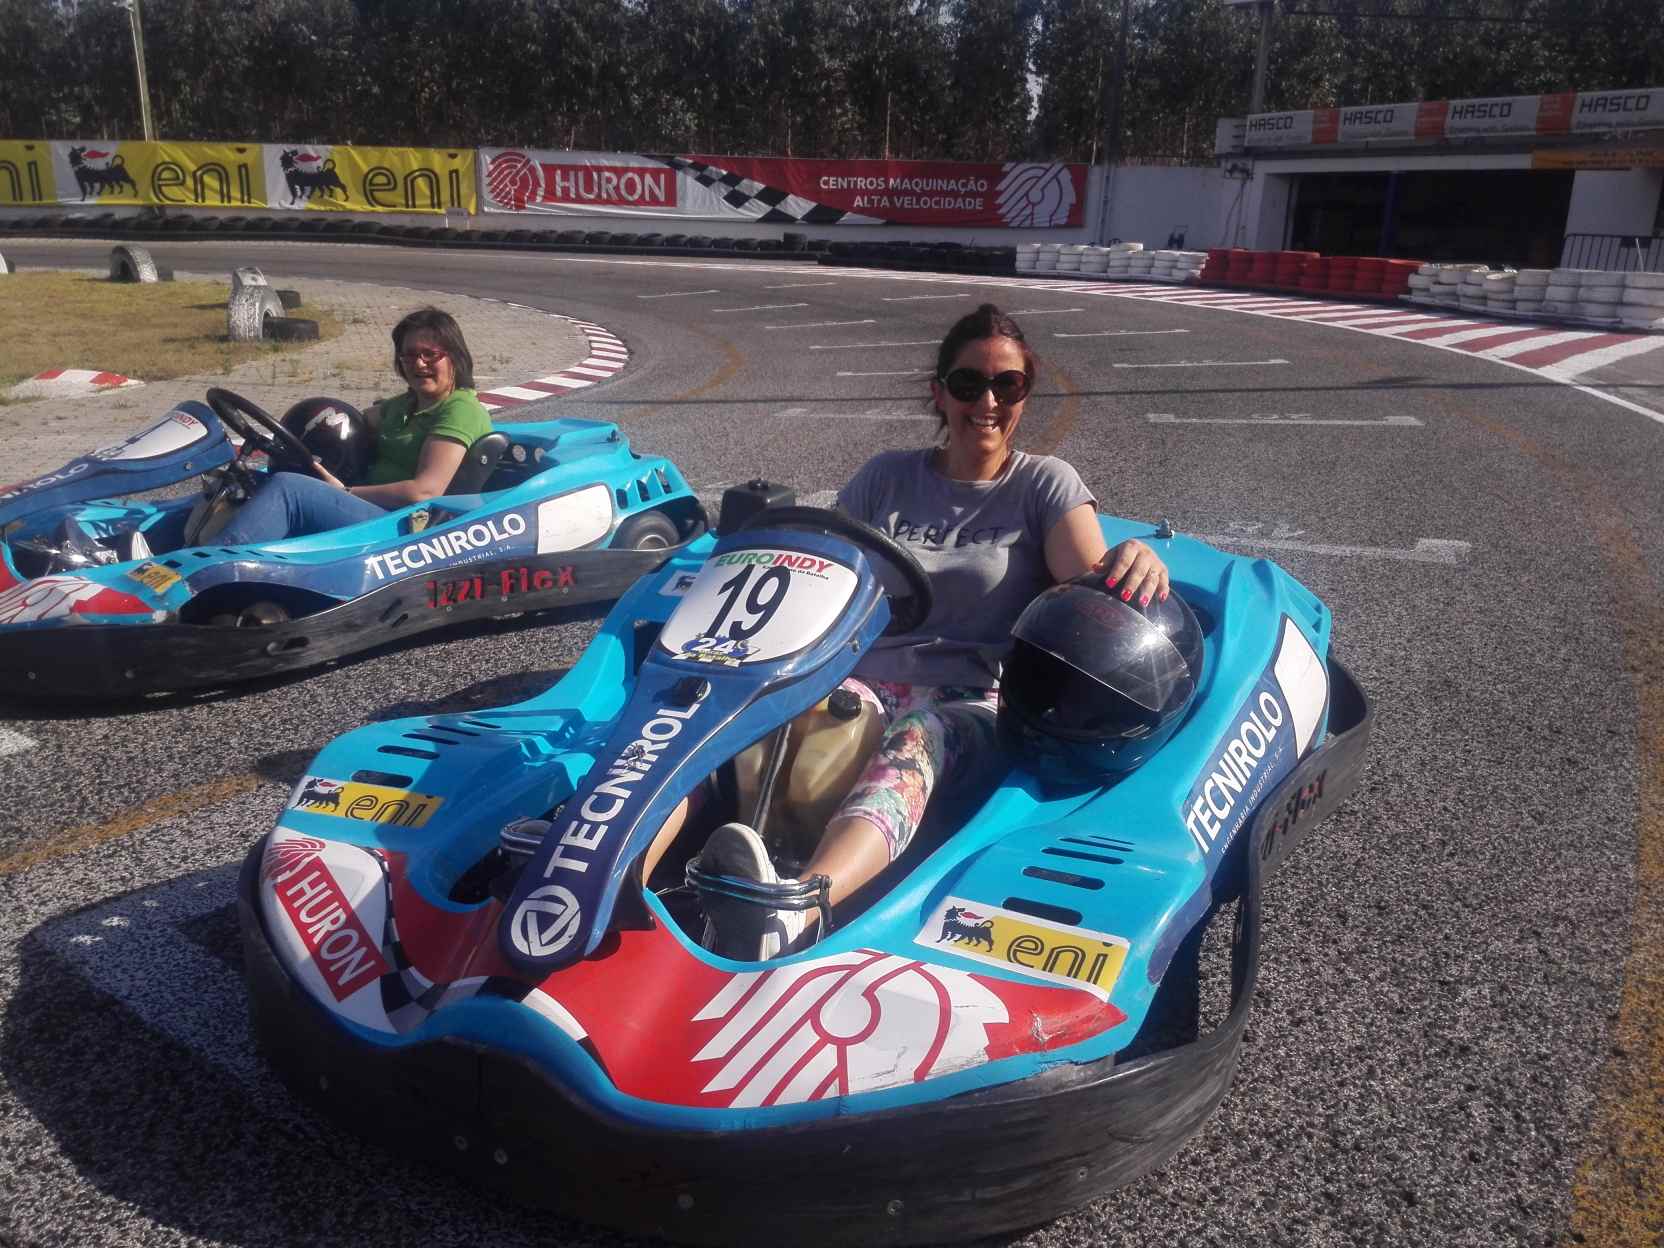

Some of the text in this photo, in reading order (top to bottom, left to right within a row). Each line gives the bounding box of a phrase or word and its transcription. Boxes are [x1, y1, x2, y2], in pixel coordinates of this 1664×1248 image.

[1343, 109, 1394, 125] HASCO
[1451, 103, 1512, 120] HASCO
[1579, 95, 1650, 113] HASCO
[1250, 115, 1294, 132] HASCO
[0, 144, 43, 201] ni
[151, 146, 252, 205] eni
[362, 152, 461, 209] eni
[555, 168, 665, 202] HURON
[819, 176, 988, 194] CENTROS MAQUINAÇÃO
[853, 195, 983, 210] ALTA VELOCIDADE
[365, 512, 526, 579] TECNIROLO
[893, 519, 1006, 549] PERFECT
[715, 552, 833, 573] EUROINDY
[701, 564, 791, 641] 19
[1186, 691, 1283, 853] TECNIROLO
[345, 793, 434, 826] eni
[286, 870, 377, 986] HURON
[1006, 933, 1114, 986] eni
